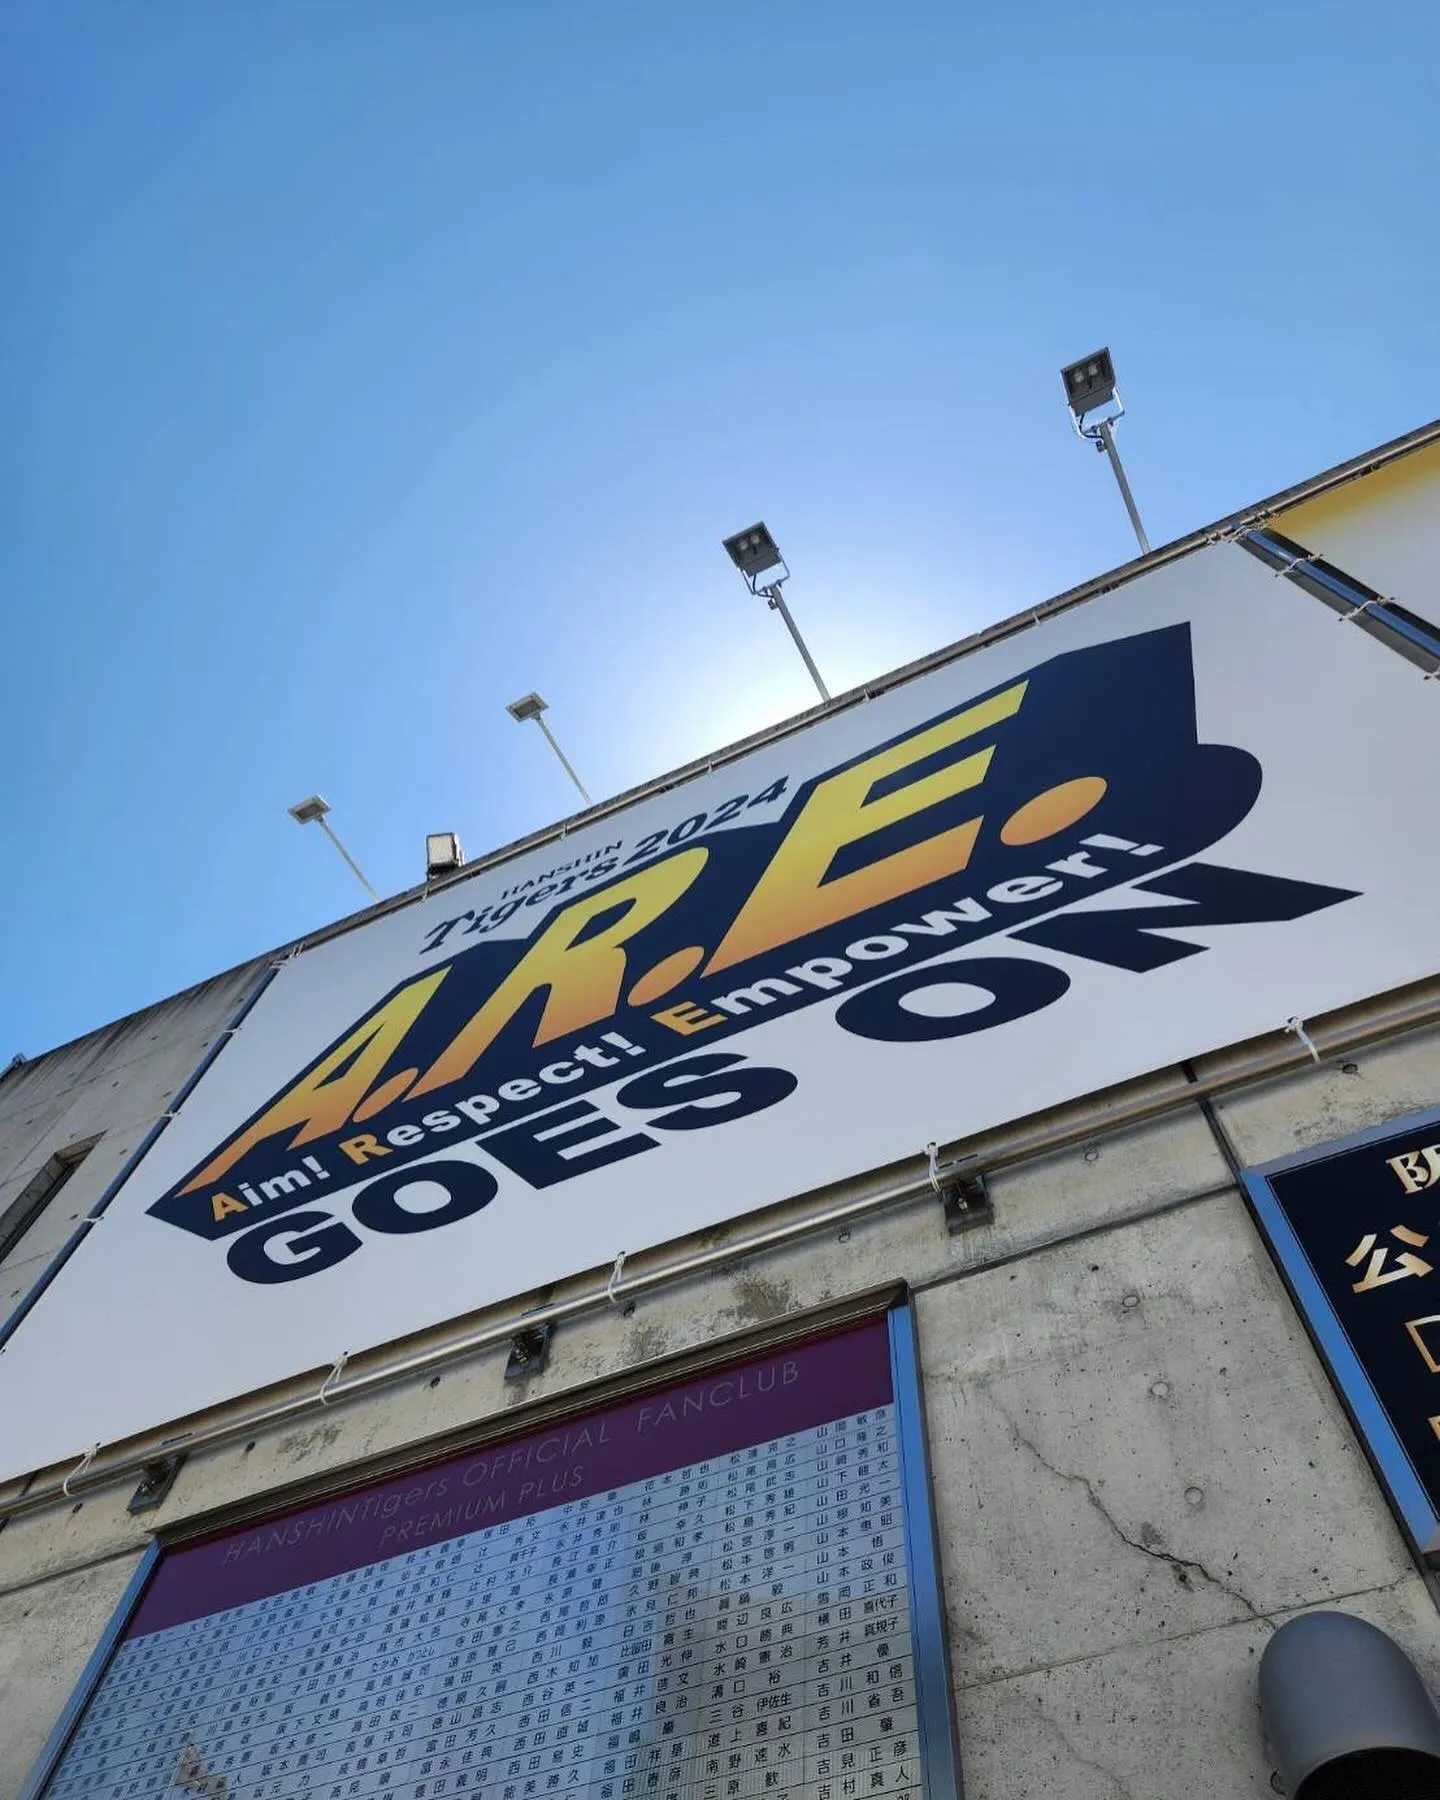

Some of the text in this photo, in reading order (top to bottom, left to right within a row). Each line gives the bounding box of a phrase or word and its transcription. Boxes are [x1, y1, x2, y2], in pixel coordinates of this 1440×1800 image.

[419, 775, 790, 955] Tigers 2024
[500, 839, 624, 899] HANSHIN
[173, 680, 1107, 1199] A.R.E.
[208, 833, 1165, 1222] Aim! Respect! Empower!
[226, 862, 1365, 1285] GOES ON
[1345, 1224, 1435, 1294] 公
[379, 1491, 506, 1547] PREMIUM
[519, 1466, 584, 1502] PLUS
[463, 1421, 612, 1487] OFFICIAL
